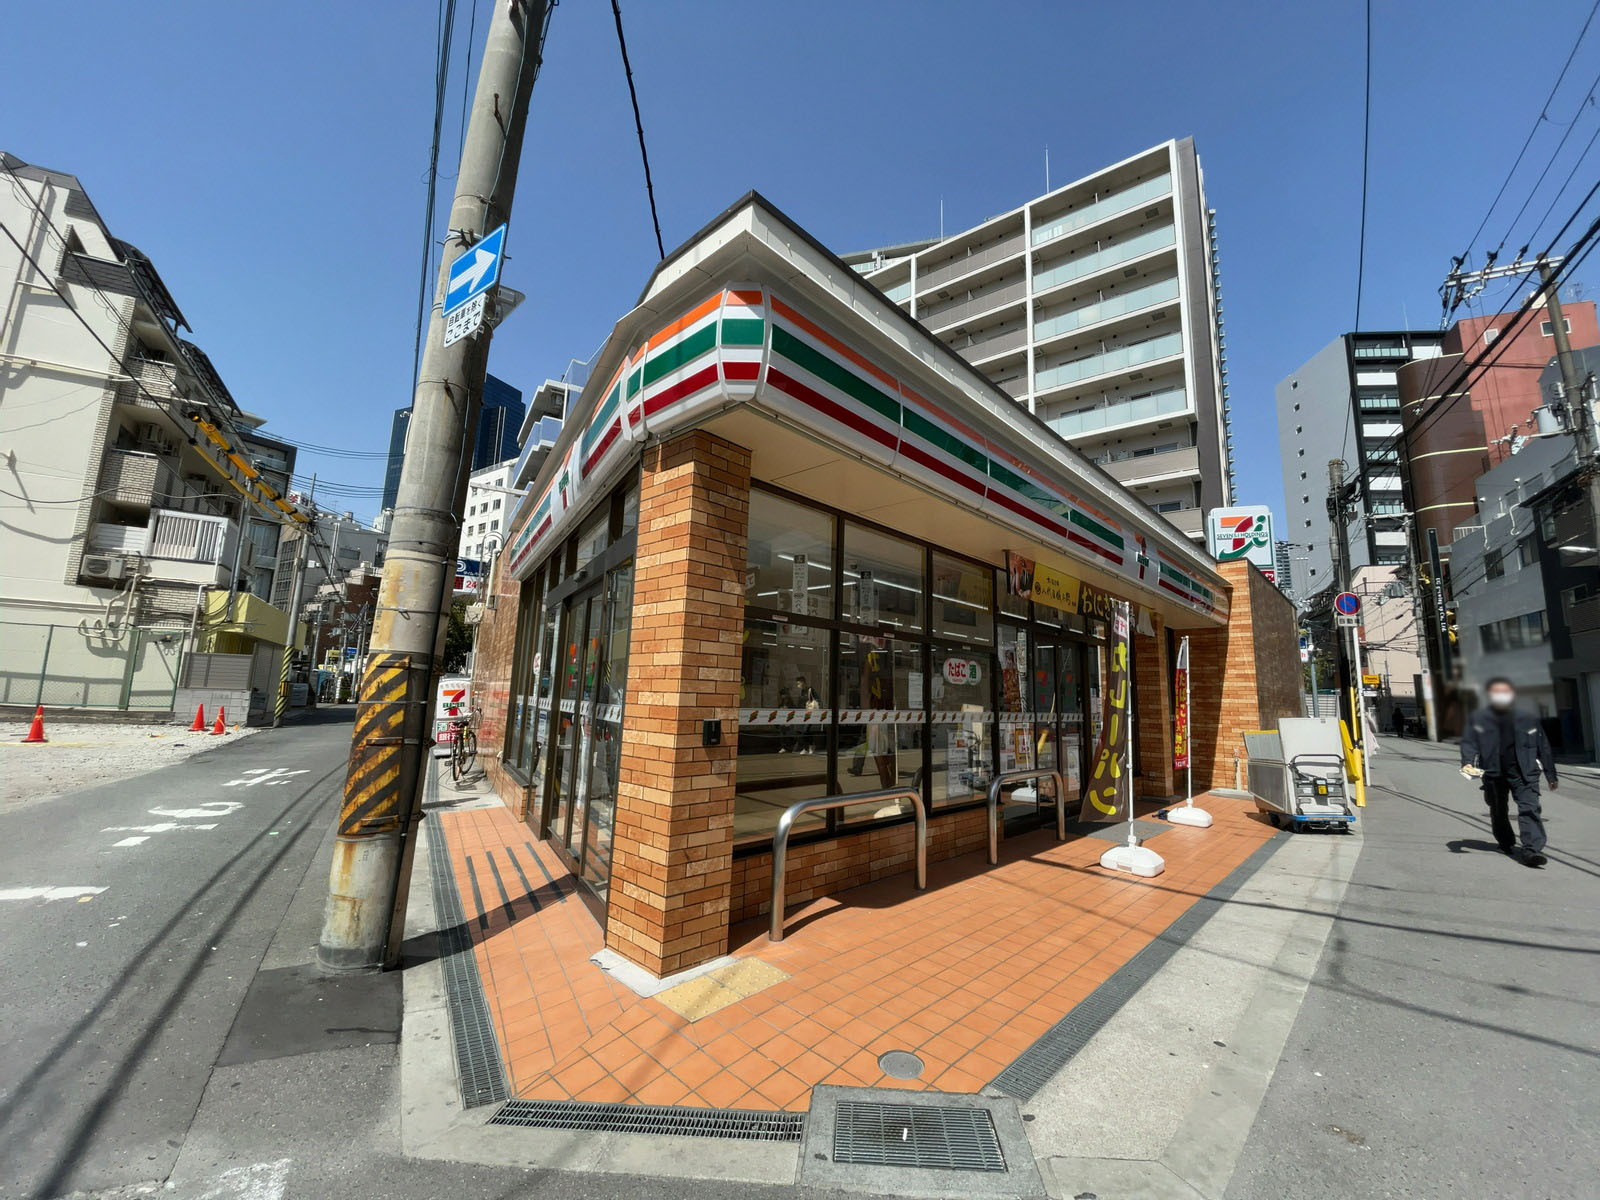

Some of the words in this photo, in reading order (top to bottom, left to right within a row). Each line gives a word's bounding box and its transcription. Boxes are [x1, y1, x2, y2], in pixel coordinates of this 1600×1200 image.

[446, 311, 480, 344] ここまで
[948, 662, 967, 678] たばこ
[969, 664, 977, 679] 酒
